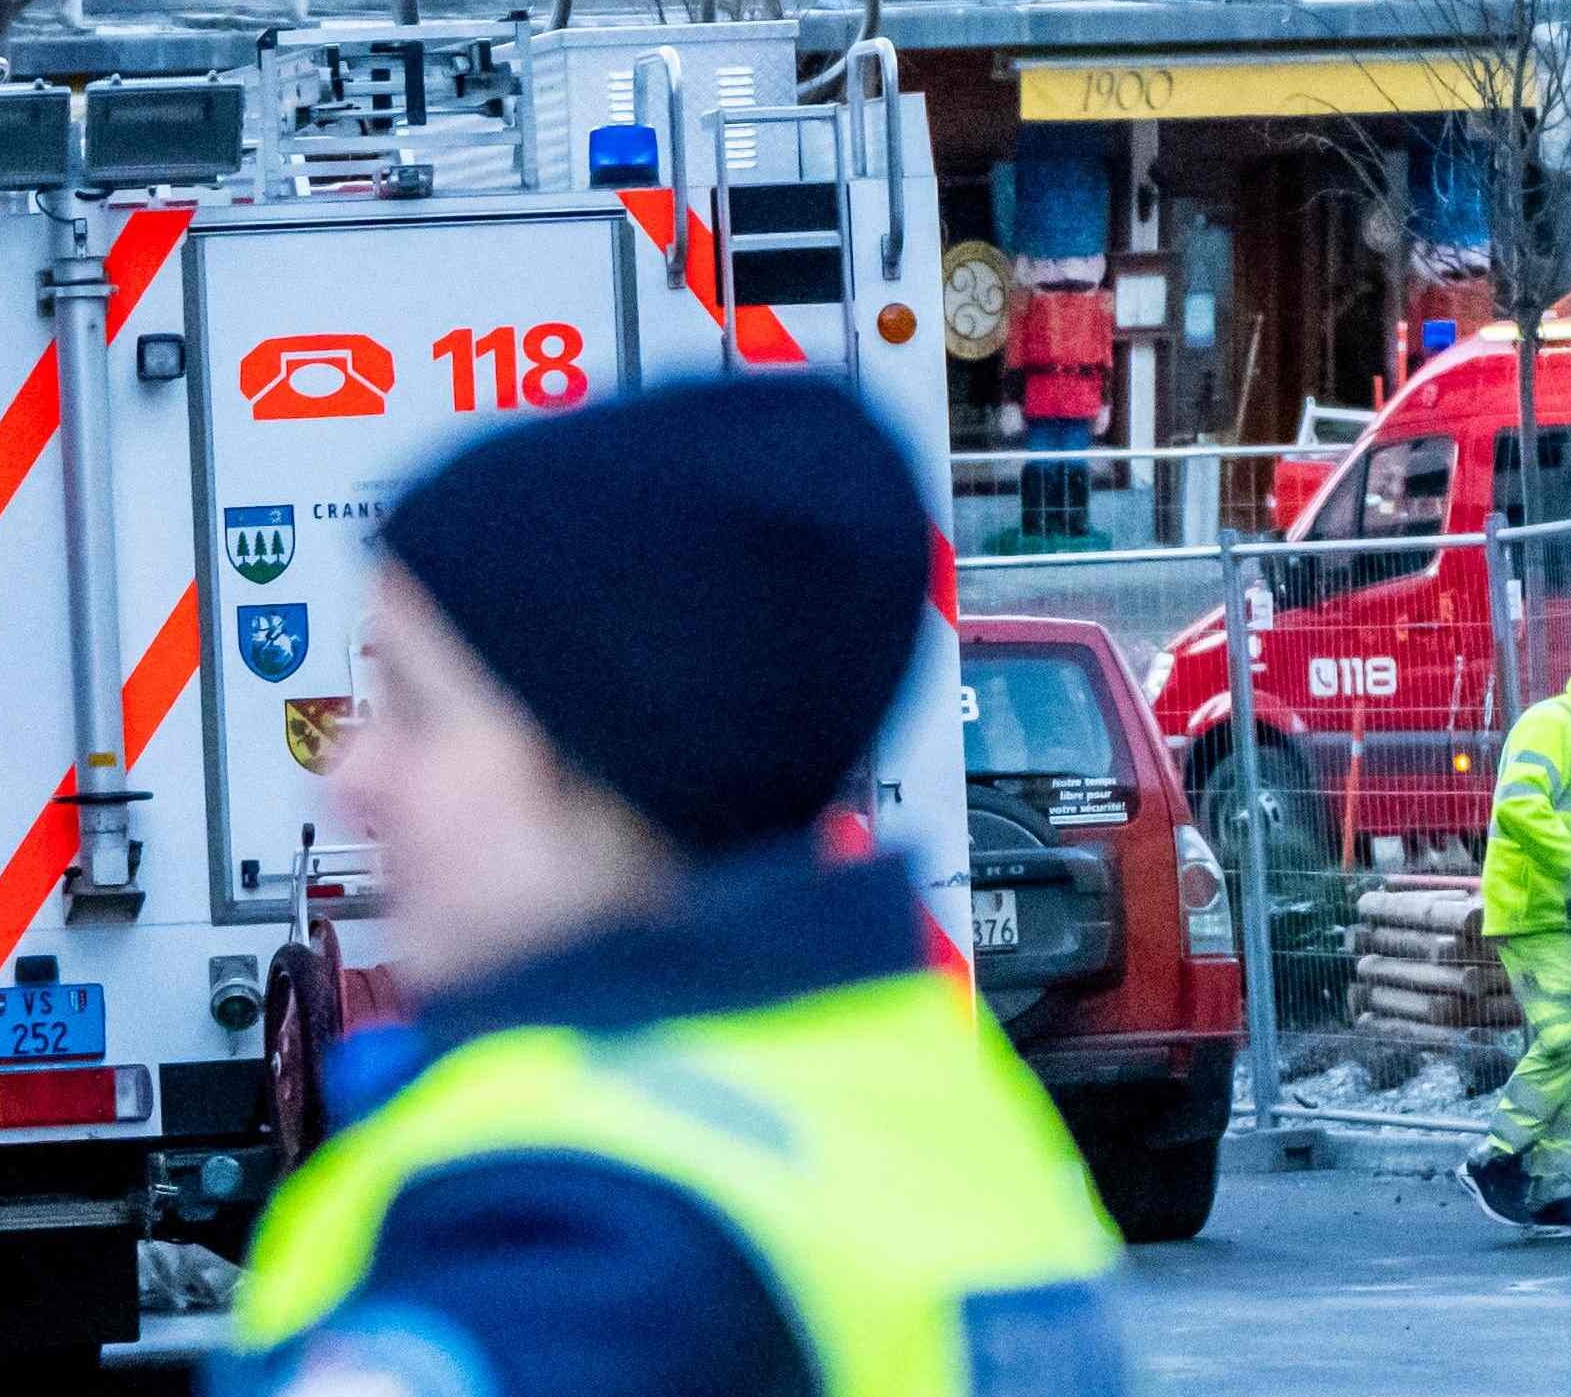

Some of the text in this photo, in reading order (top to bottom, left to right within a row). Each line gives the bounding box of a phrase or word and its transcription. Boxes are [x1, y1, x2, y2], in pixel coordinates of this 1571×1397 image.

[1081, 69, 1175, 113] 1900
[432, 322, 589, 413] 118
[313, 502, 385, 520] CRANS
[1339, 656, 1398, 697] 118
[1059, 790, 1113, 803] libre pour
[1084, 776, 1117, 788] temps
[23, 990, 53, 1016] VS
[12, 1021, 69, 1054] 252
